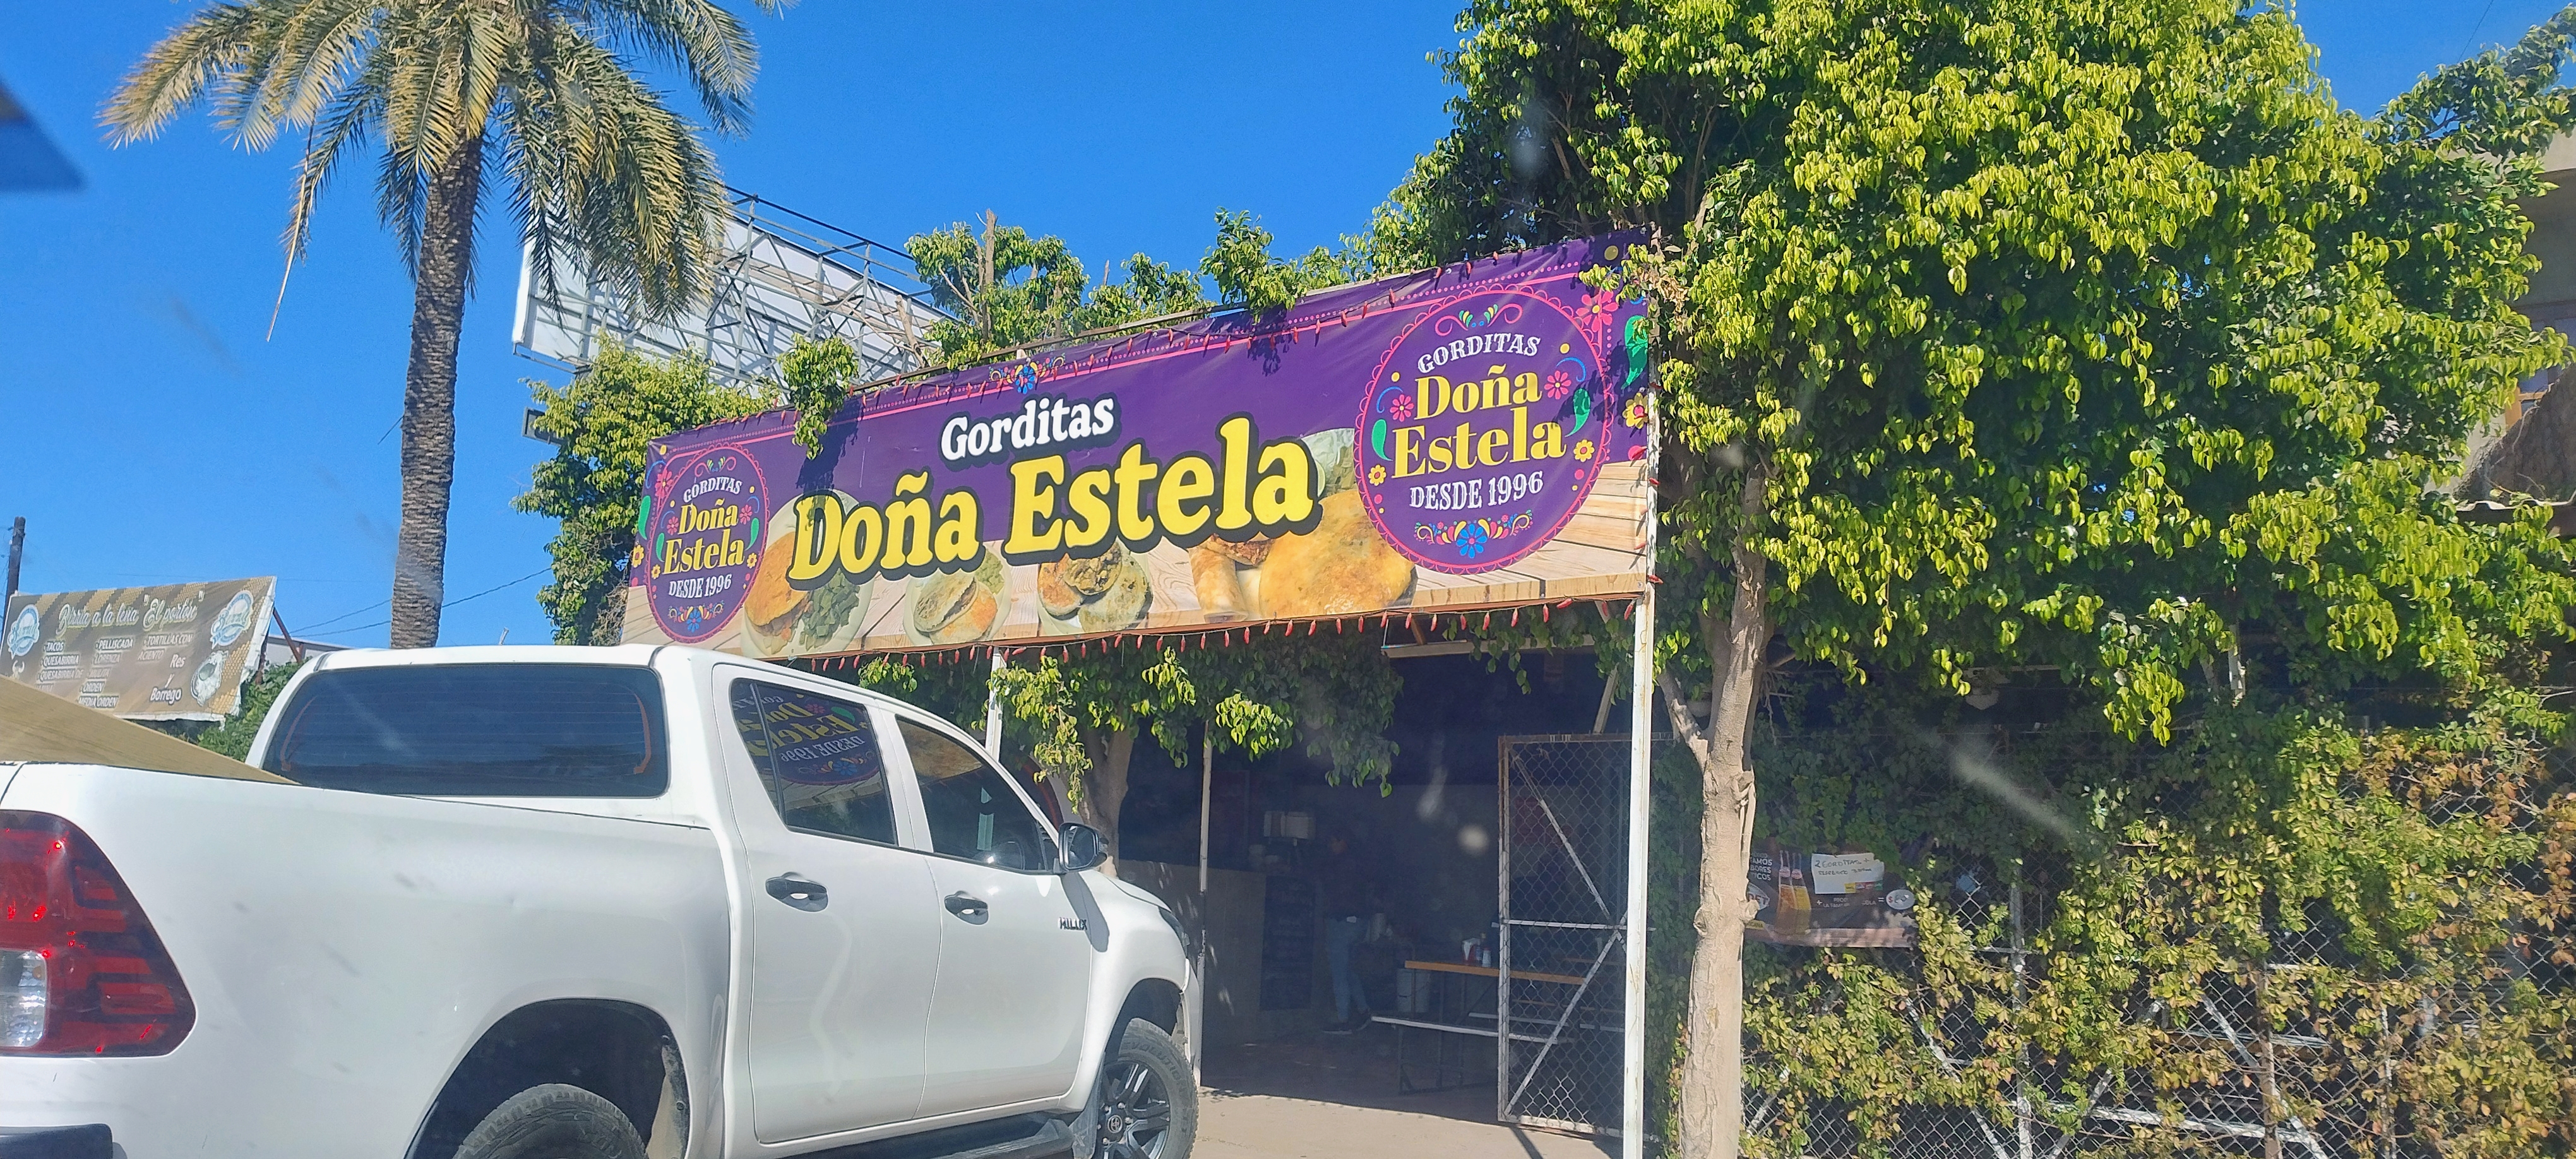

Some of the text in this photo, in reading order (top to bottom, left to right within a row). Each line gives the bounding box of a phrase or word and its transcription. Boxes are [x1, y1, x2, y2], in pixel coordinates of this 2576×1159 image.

[1417, 333, 1541, 373] GORDITAS
[1414, 364, 1542, 420] Doña
[943, 397, 1114, 461] Gorditas
[1392, 407, 1566, 479] Estela
[683, 477, 742, 503] GORDITAS
[792, 417, 1315, 581] Doña Estela
[1410, 470, 1544, 510] DESDE 1996
[678, 498, 739, 535] Doña
[662, 529, 745, 575] Estela
[668, 574, 732, 598] DESDE 1996
[56, 603, 90, 636] Birria
[93, 611, 100, 626] a
[102, 603, 114, 626] la
[47, 641, 64, 651] TACOS
[98, 638, 133, 650] PELLISCADA
[147, 634, 179, 646] TORTILLAS
[44, 655, 79, 666] QUESABIRRIA
[170, 654, 186, 668] Res
[40, 669, 75, 682] QUESABIRRIA
[83, 682, 104, 693] ORDEN
[150, 687, 182, 704] Borrego
[97, 696, 119, 708] ORDEN
[1815, 860, 1821, 868] 2
[1059, 917, 1087, 930] HILUX
